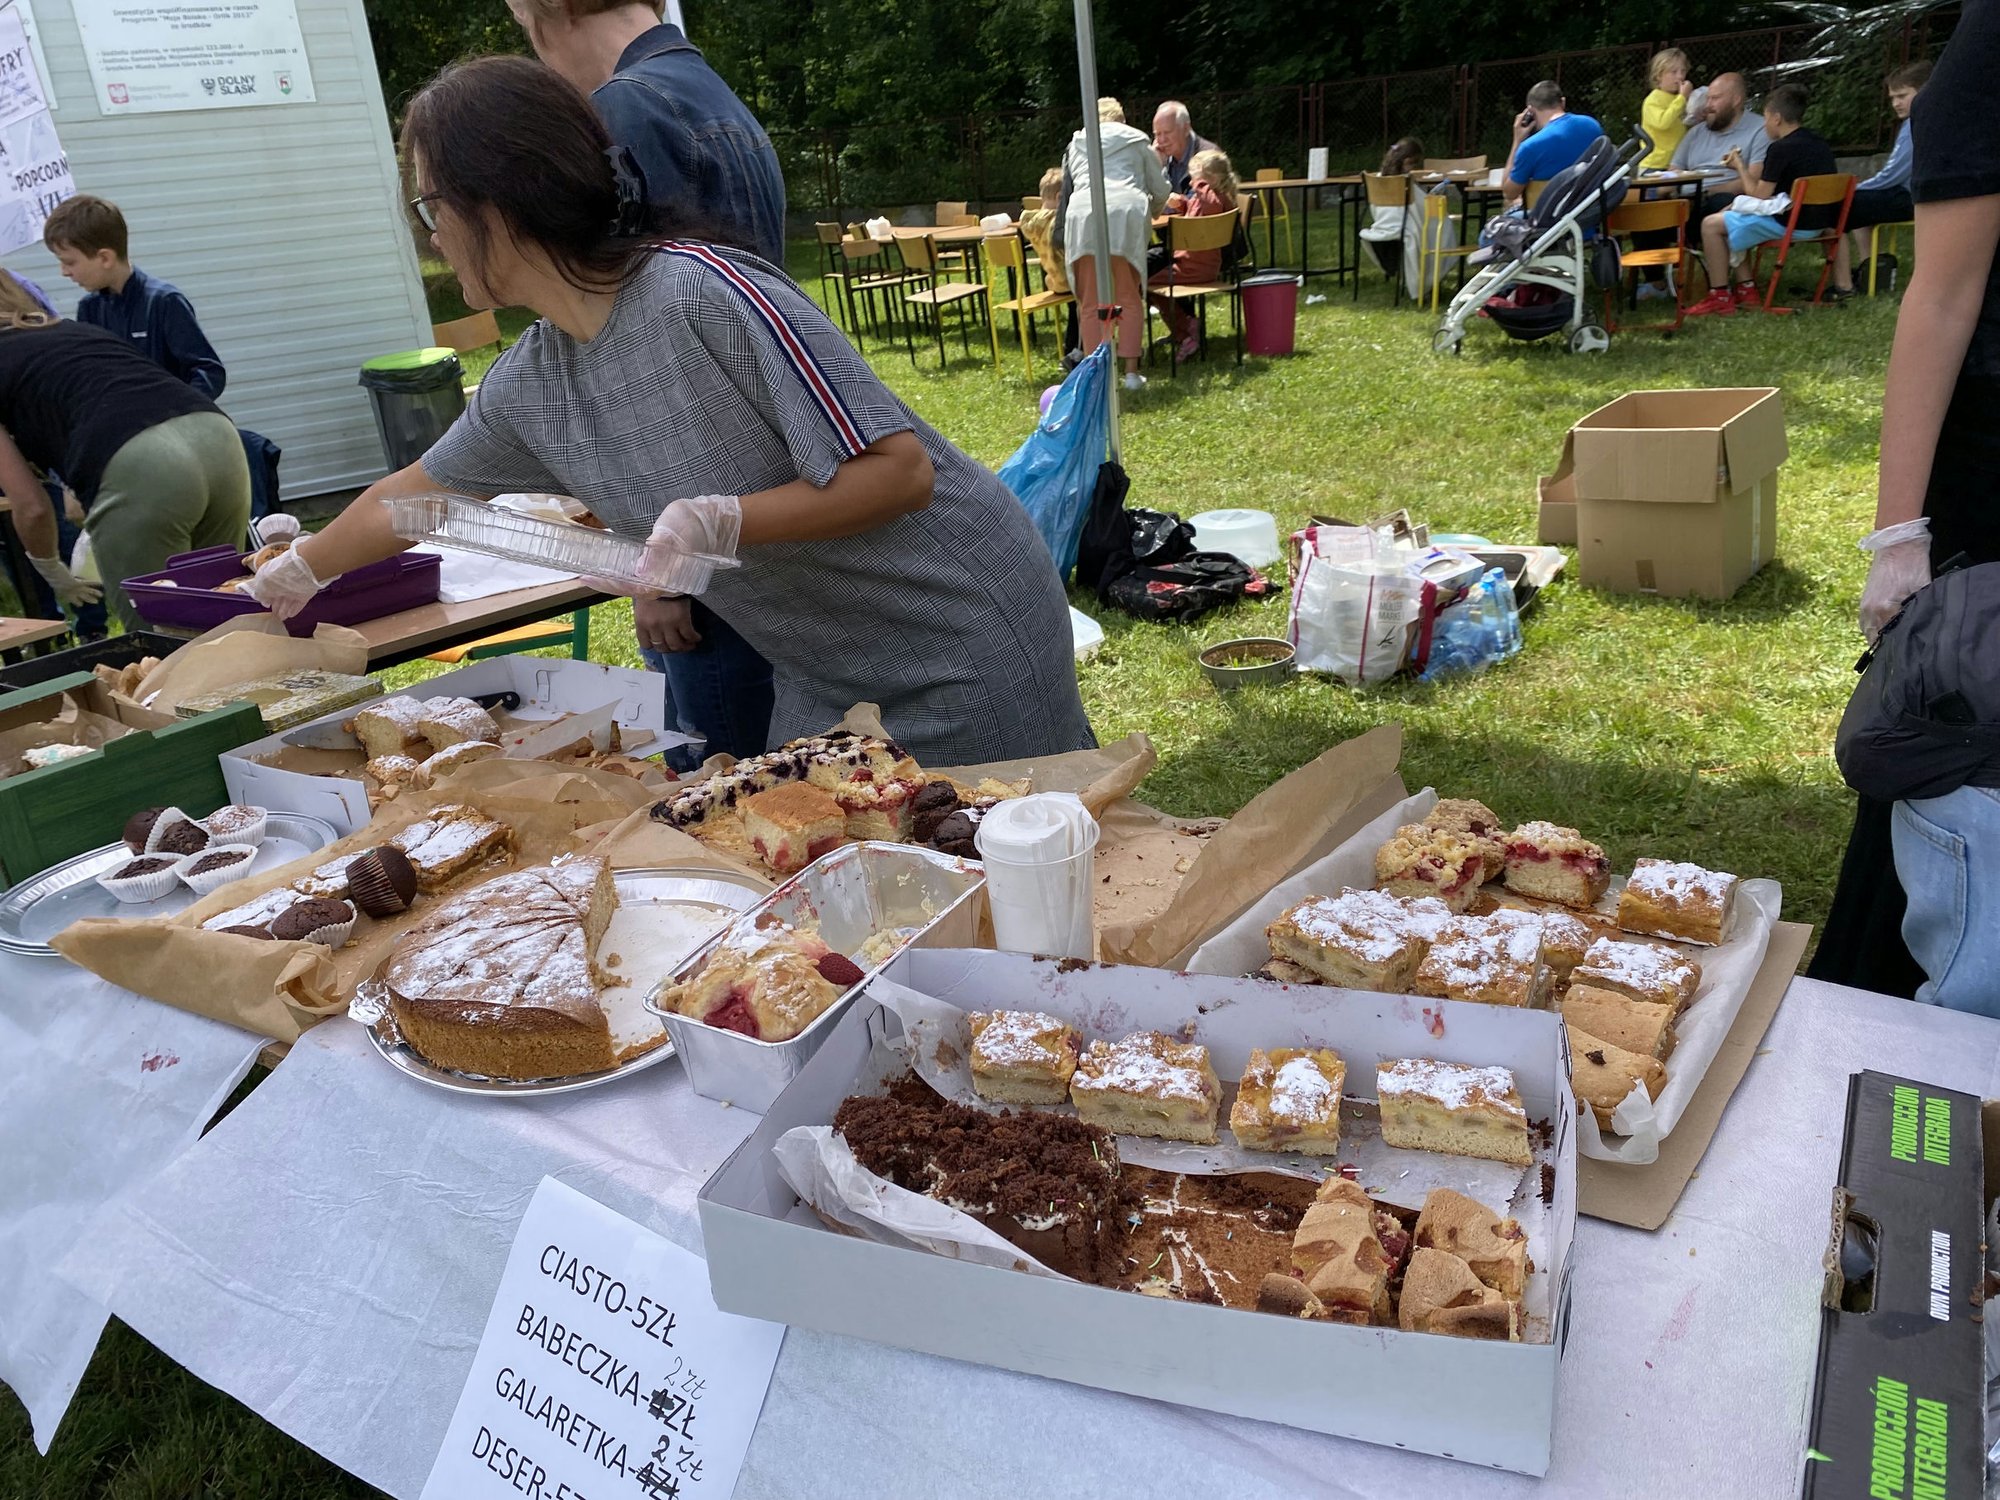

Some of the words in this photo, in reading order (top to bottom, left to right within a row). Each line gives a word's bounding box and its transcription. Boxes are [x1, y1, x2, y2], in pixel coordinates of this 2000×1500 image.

[217, 75, 255, 86] DOLNY
[15, 157, 70, 192] POPCORN
[1888, 1085, 1920, 1163] PRODUCCIÓN
[1923, 1097, 1951, 1166] INTEGRADA
[1930, 1230, 1951, 1293] PRODUCTION
[539, 1244, 679, 1348] CIASTO-5ZŁ
[1929, 1291, 1950, 1322] OWN
